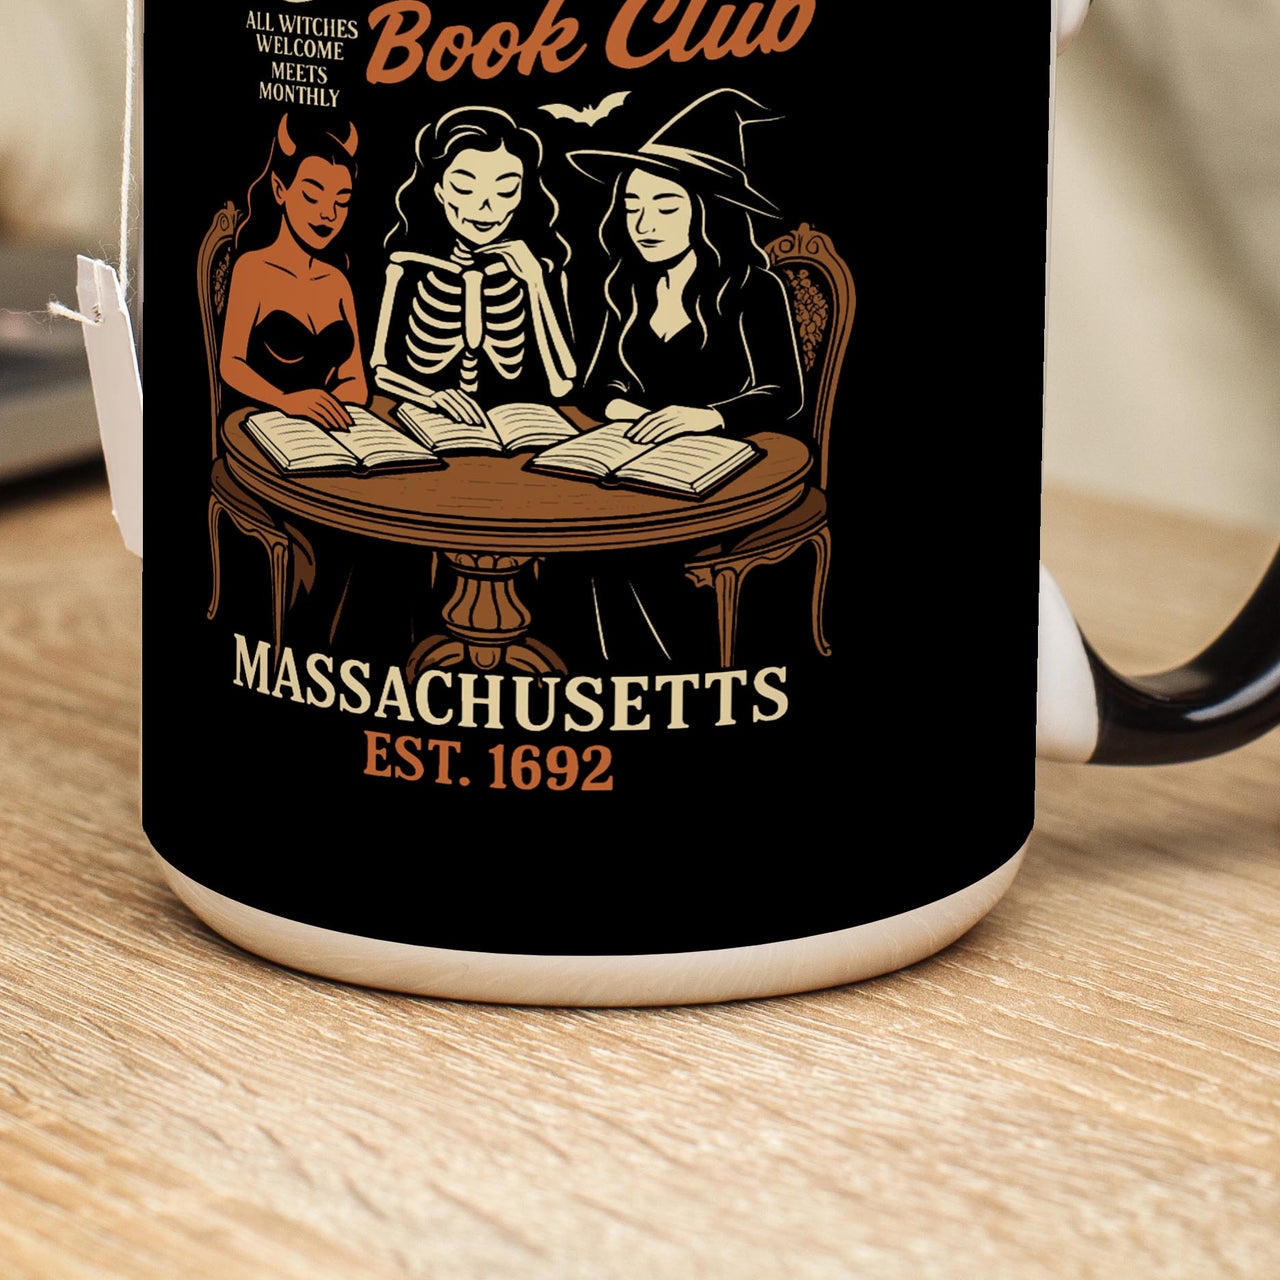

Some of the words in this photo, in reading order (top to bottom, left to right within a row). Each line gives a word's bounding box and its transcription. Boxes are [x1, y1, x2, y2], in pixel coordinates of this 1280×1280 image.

[246, 10, 275, 32] ALL
[278, 14, 359, 40] WITCHES
[256, 33, 345, 61] WELCOME
[271, 61, 328, 85] MEETS
[259, 81, 340, 108] MONTHLY
[233, 633, 789, 733] MASSACHUSETTS
[363, 730, 471, 787] EST.
[488, 743, 614, 791] 1692
